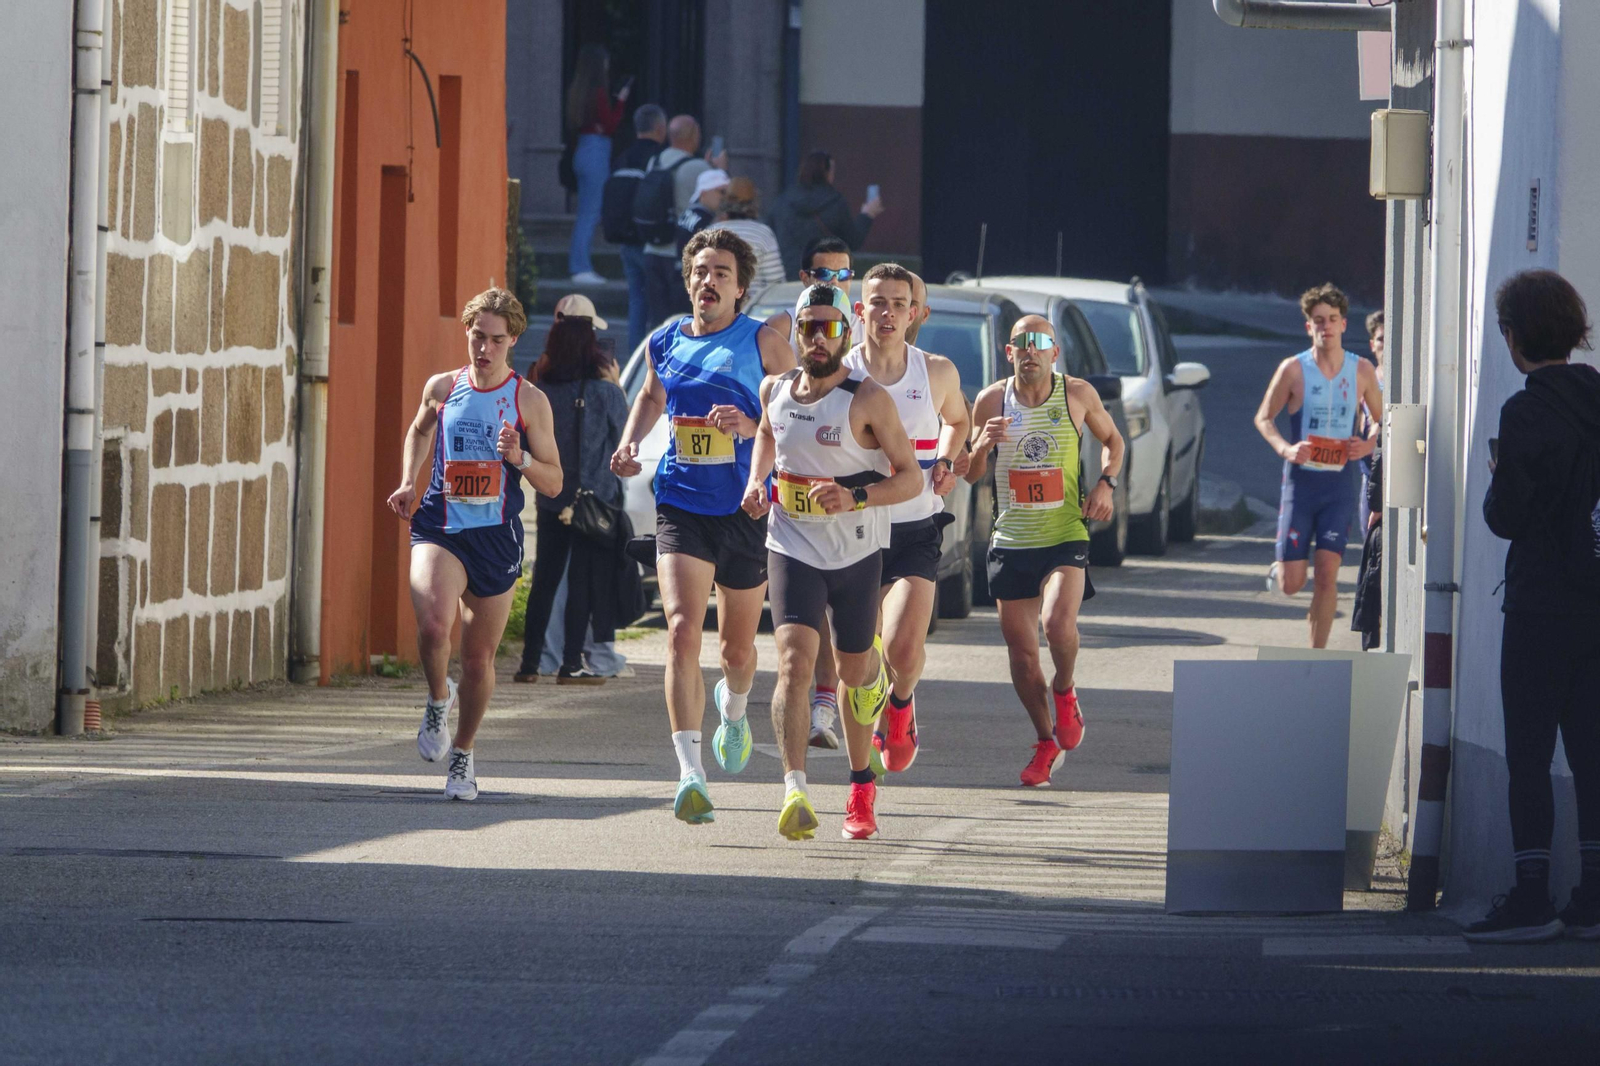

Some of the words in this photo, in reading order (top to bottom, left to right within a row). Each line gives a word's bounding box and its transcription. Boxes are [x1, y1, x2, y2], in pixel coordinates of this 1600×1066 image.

[691, 434, 712, 455] 87
[1312, 446, 1343, 464] 2013
[454, 475, 491, 495] 2012
[1028, 483, 1044, 502] 13
